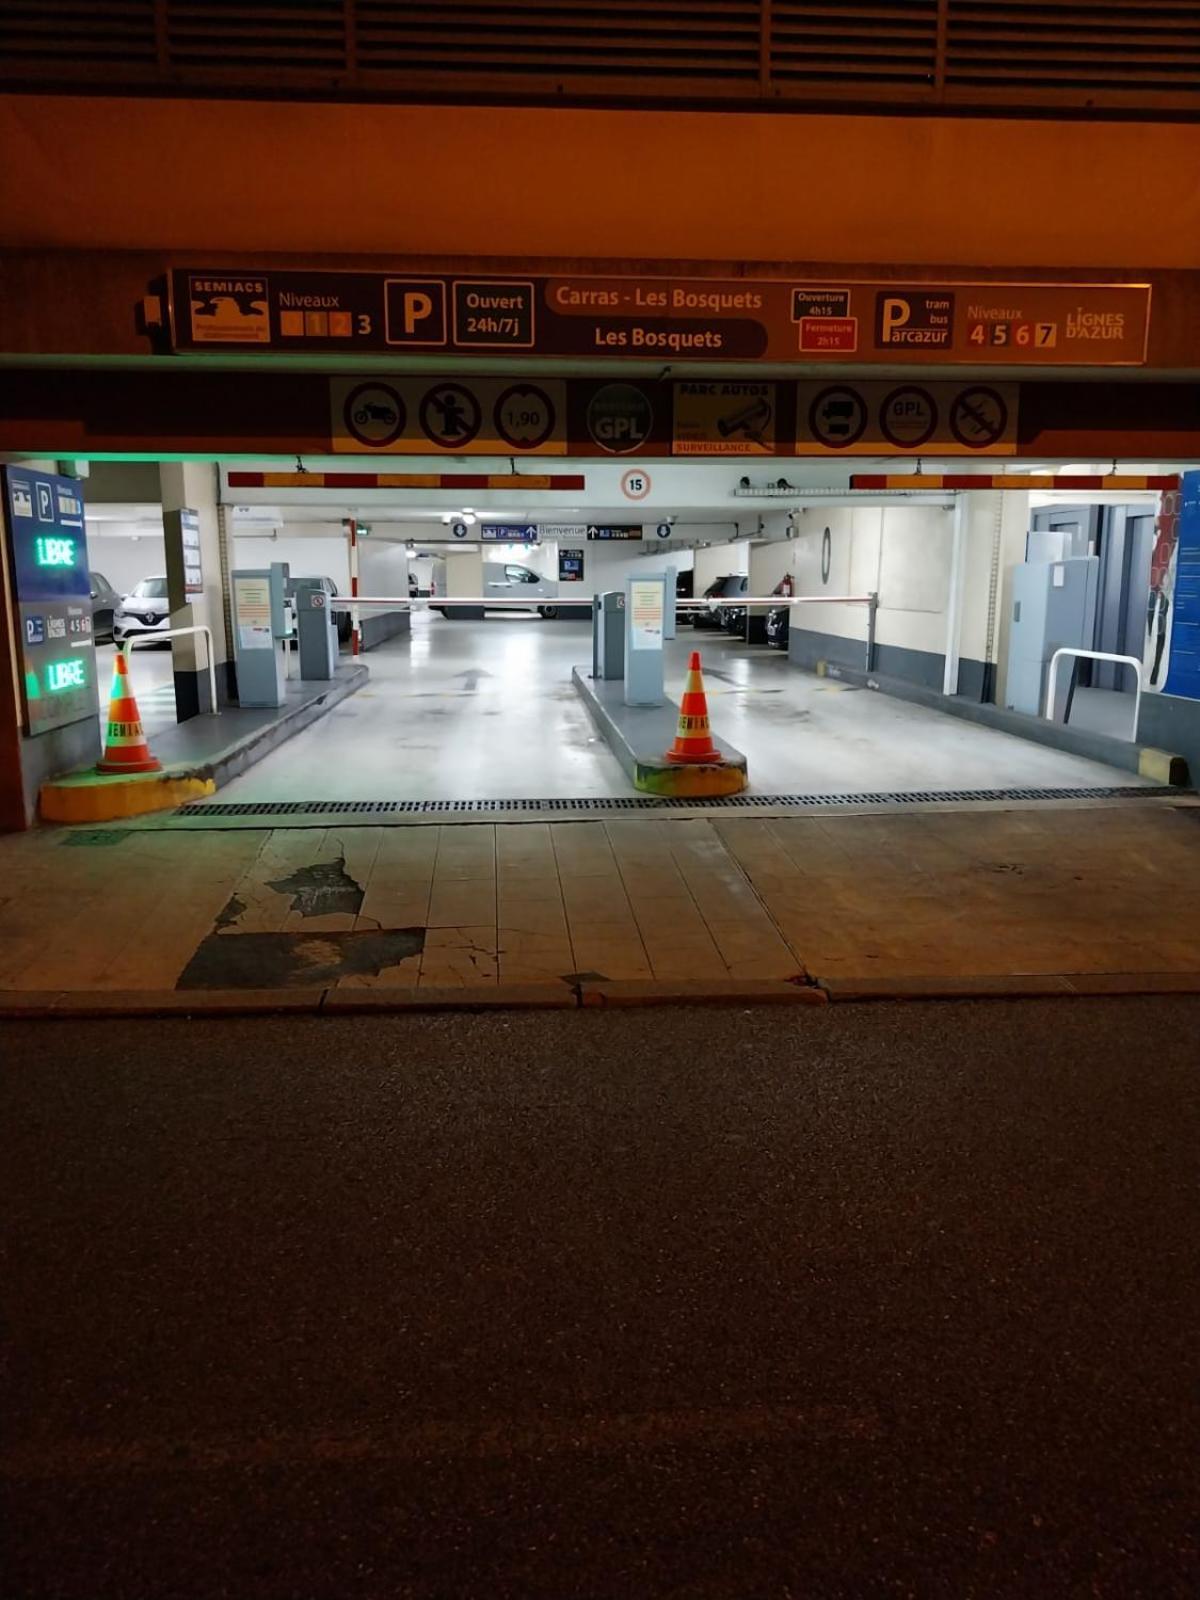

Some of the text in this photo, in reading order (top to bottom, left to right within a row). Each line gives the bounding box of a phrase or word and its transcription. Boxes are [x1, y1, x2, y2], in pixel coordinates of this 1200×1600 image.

[195, 281, 263, 293] SEMIACS
[279, 292, 340, 307] Niveaux
[466, 293, 523, 309] Ouvert
[556, 286, 619, 305] Carras
[635, 288, 667, 306] Les
[673, 289, 763, 312] Bosquets
[798, 292, 845, 303] Ouverture
[926, 300, 950, 309] tram
[404, 292, 433, 333] P
[930, 315, 948, 324] bus
[968, 306, 1023, 320] Niveaux
[358, 314, 372, 334] 3
[467, 318, 519, 337] 24h/7j
[805, 322, 853, 334] Fermeture
[595, 328, 723, 351] Les Bosquets
[971, 325, 1053, 345] 4 5 6 7
[1066, 326, 1124, 340] D'AZUR
[680, 384, 769, 395] PARC AUTOS
[893, 401, 926, 416] GPL
[507, 411, 540, 429] 1,90
[596, 417, 644, 440] GPL
[676, 443, 752, 452] SURVEILLANCE
[630, 479, 642, 491] 15
[40, 490, 49, 514] P
[540, 524, 585, 534] Bienvenue
[37, 538, 75, 566] LIBRE
[48, 660, 85, 690] LIBRE
